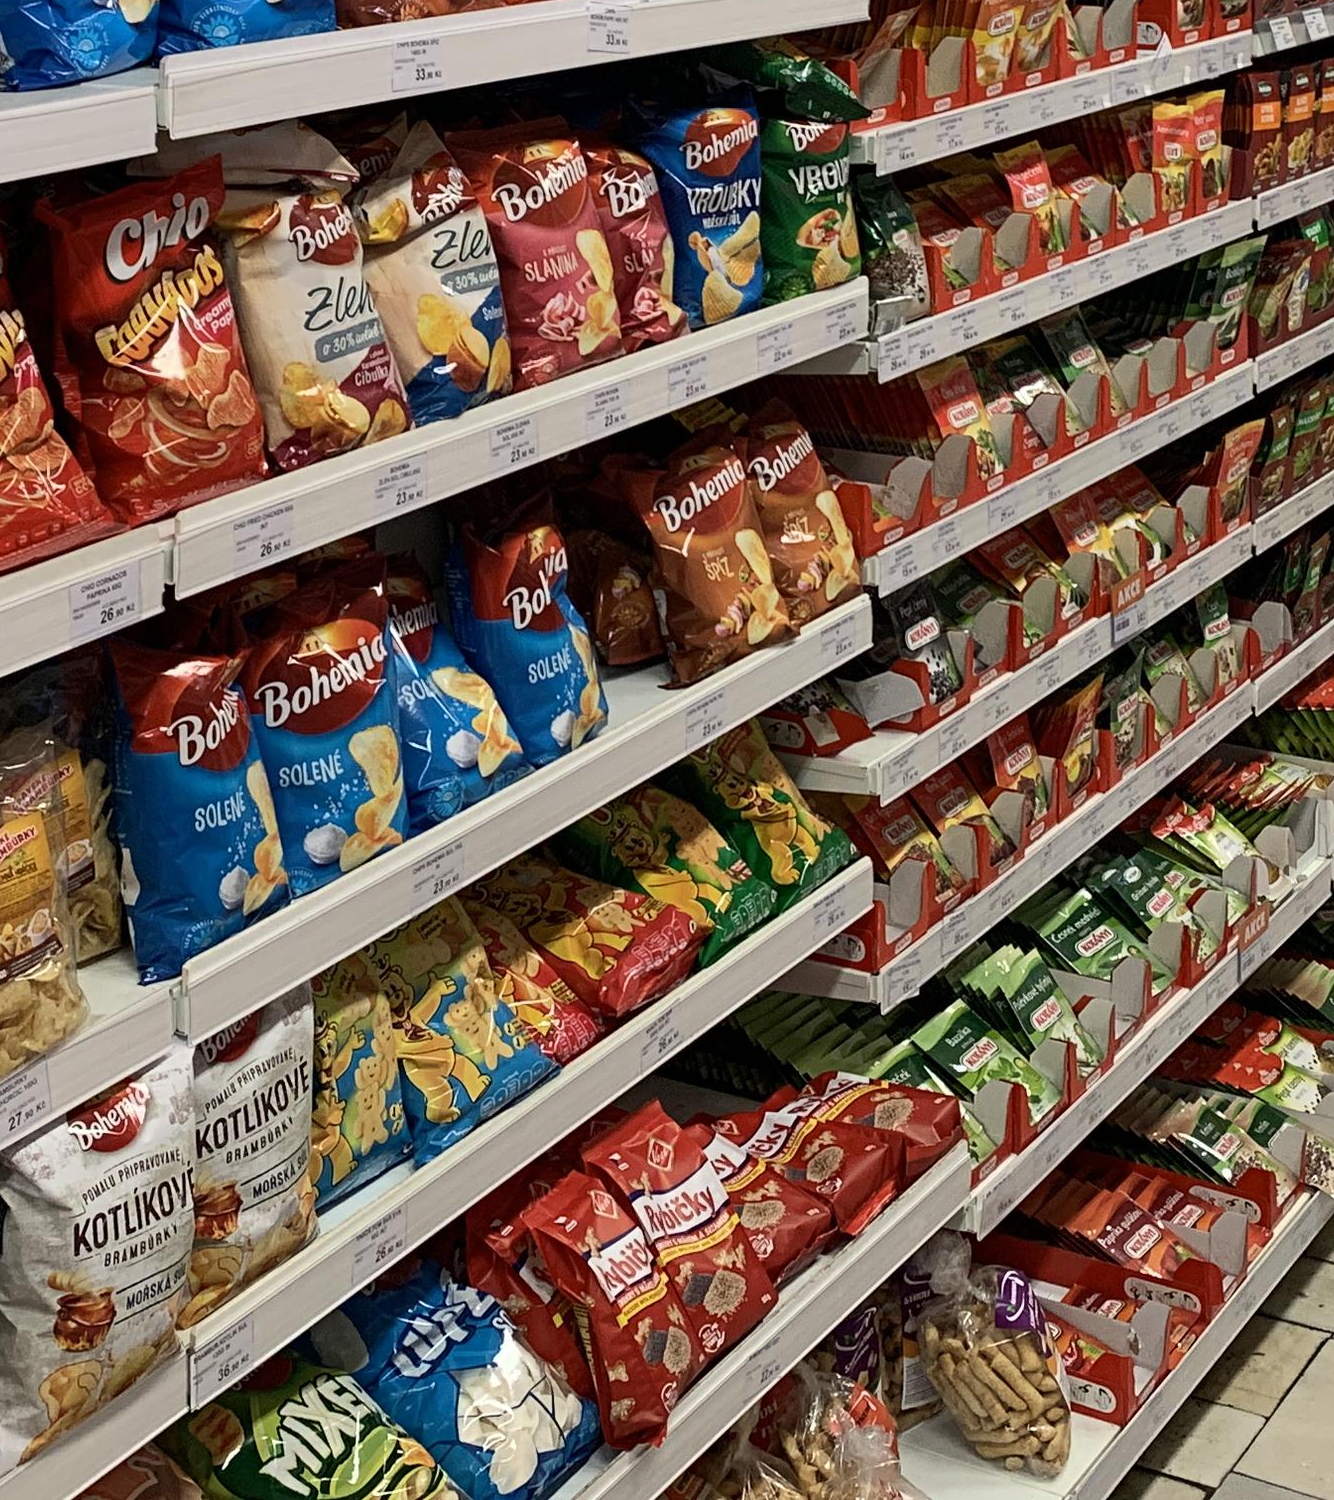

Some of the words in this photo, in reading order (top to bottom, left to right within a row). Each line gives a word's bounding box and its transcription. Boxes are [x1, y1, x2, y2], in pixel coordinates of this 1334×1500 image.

[683, 117, 759, 171] Bohemia
[106, 191, 210, 282] Chio
[95, 243, 224, 367] CORNADOS
[652, 457, 746, 534] Bohemia
[254, 631, 390, 729] Bohemia
[278, 755, 344, 789] SOLENÉ
[194, 791, 247, 832] SOLENÉ
[68, 1080, 151, 1152] Bohemia
[194, 1056, 311, 1159] KOTLÍKOVÉ
[82, 1177, 117, 1206] POMALU
[118, 1146, 182, 1184] PŘIPRAVOVANÉ
[642, 1182, 715, 1235] Rybičky
[72, 1162, 195, 1257] KOTLÍKOVÉ
[103, 1224, 179, 1268] BRAMBŮRKY
[124, 1277, 172, 1311] MOŘSKÁ
